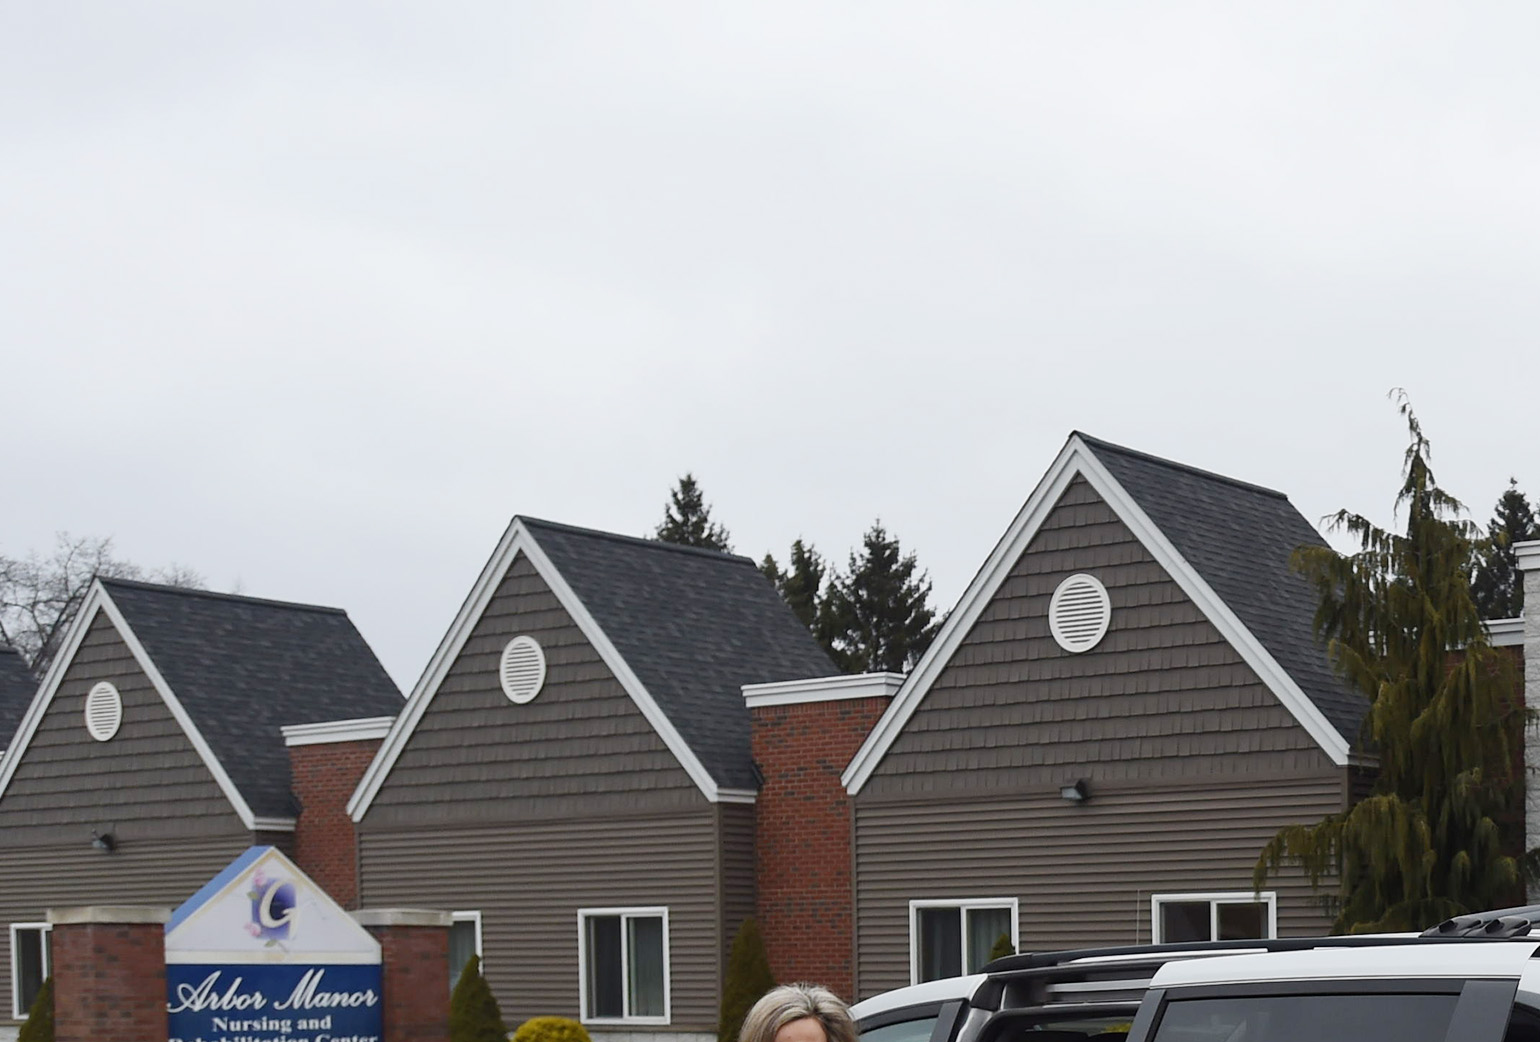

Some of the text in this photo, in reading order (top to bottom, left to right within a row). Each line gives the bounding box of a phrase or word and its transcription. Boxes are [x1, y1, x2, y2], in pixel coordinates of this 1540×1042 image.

[167, 968, 378, 1013] Arbor Manor
[212, 1015, 332, 1034] Nursing and
